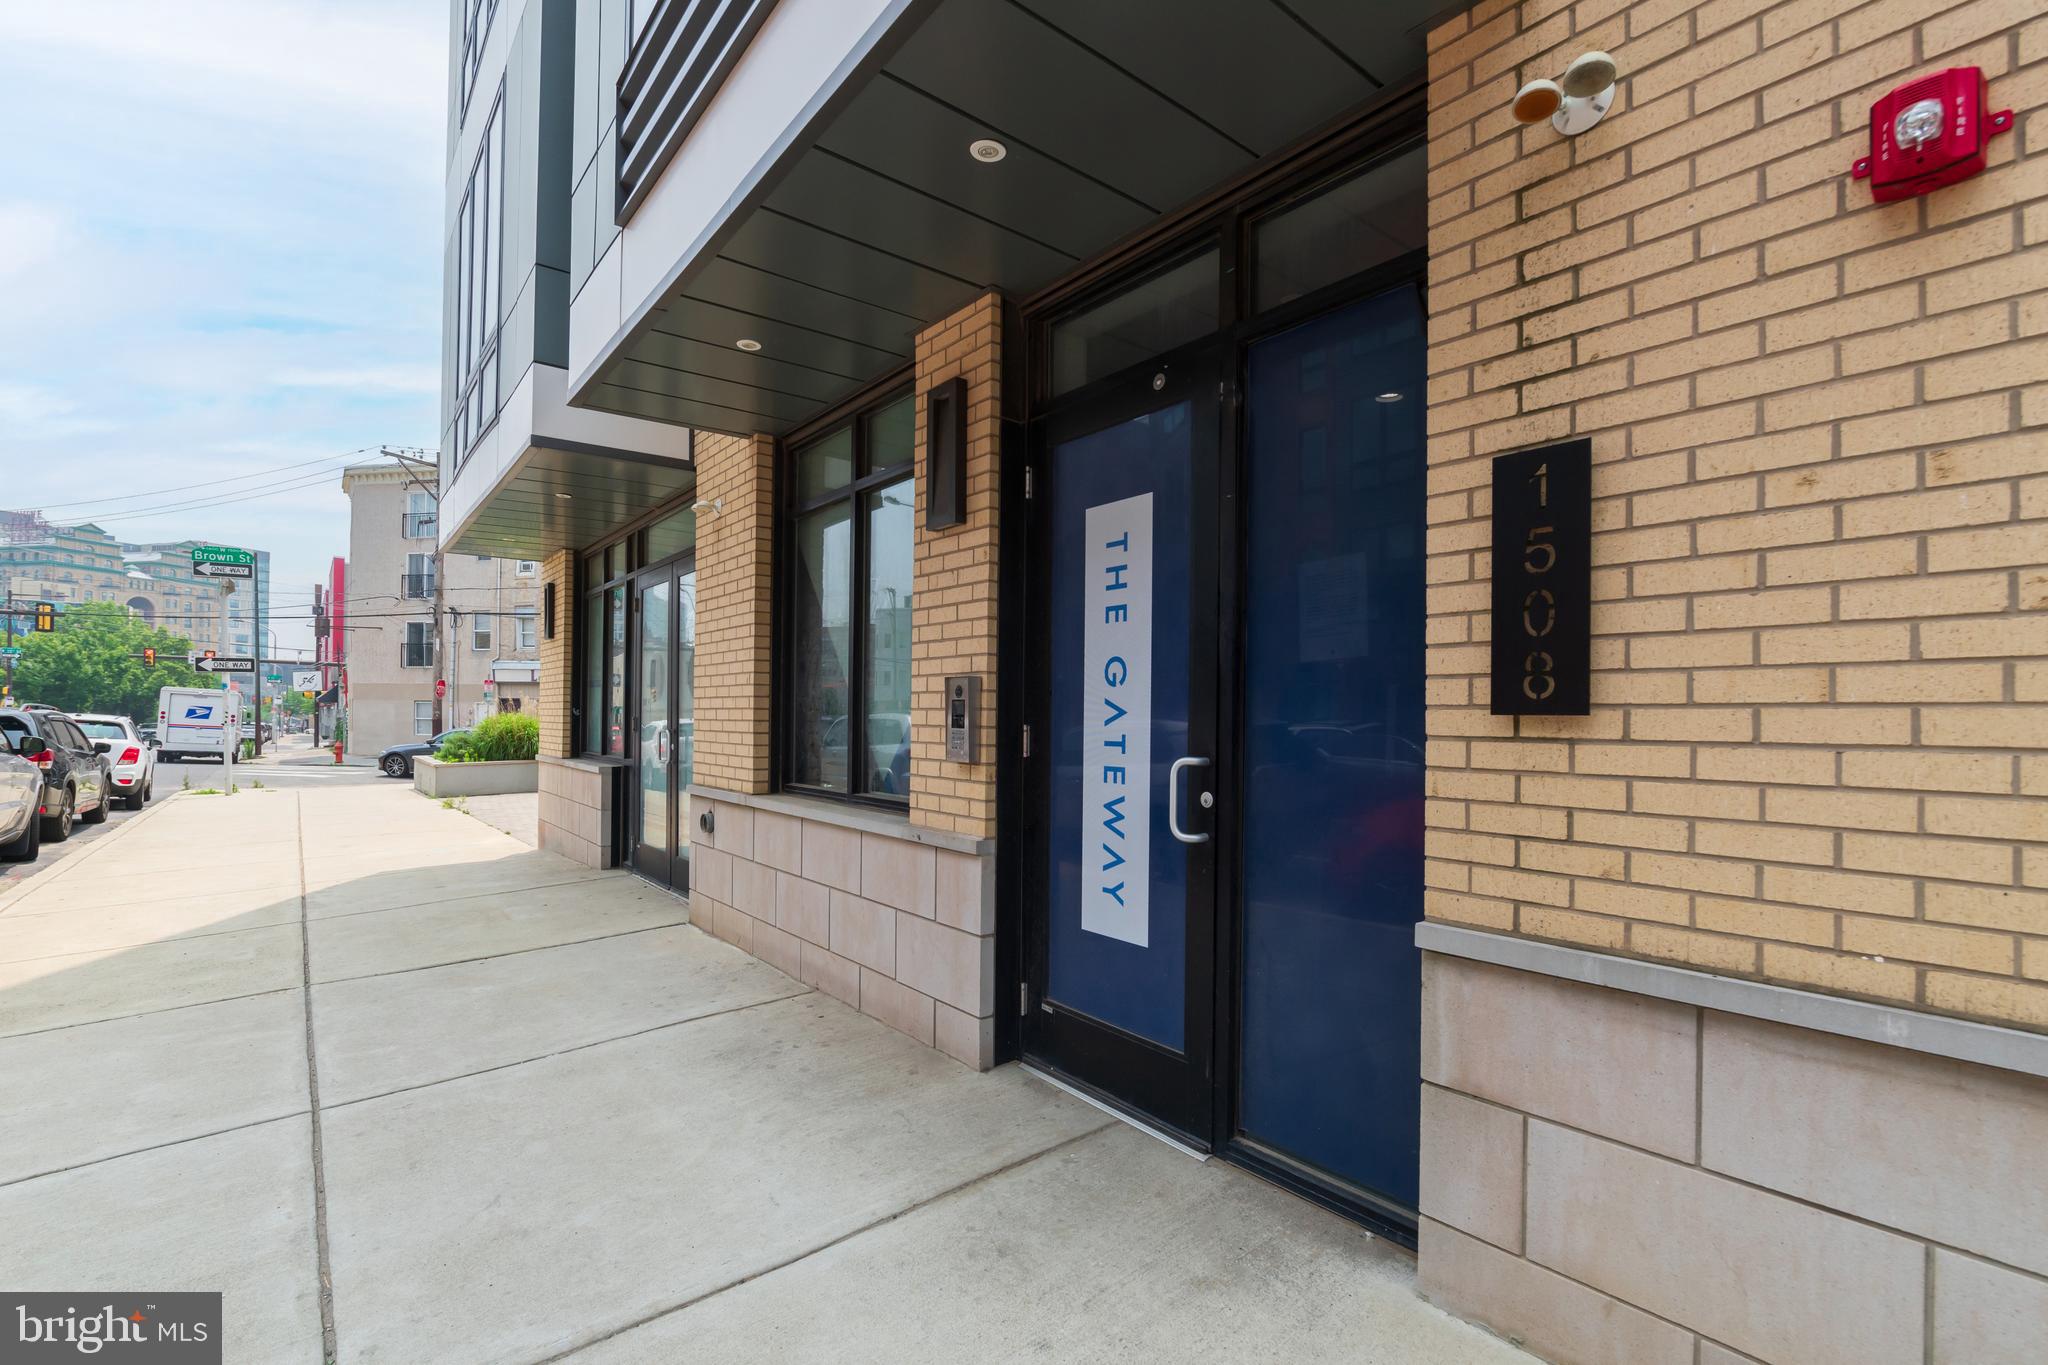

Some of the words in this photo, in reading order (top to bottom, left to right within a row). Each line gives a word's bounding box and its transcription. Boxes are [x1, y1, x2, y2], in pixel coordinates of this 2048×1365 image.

[194, 550, 234, 562] Brown
[239, 554, 251, 563] St
[1104, 531, 1129, 624] THE
[1523, 463, 1556, 701] 1508
[1101, 656, 1129, 907] GATEWAY
